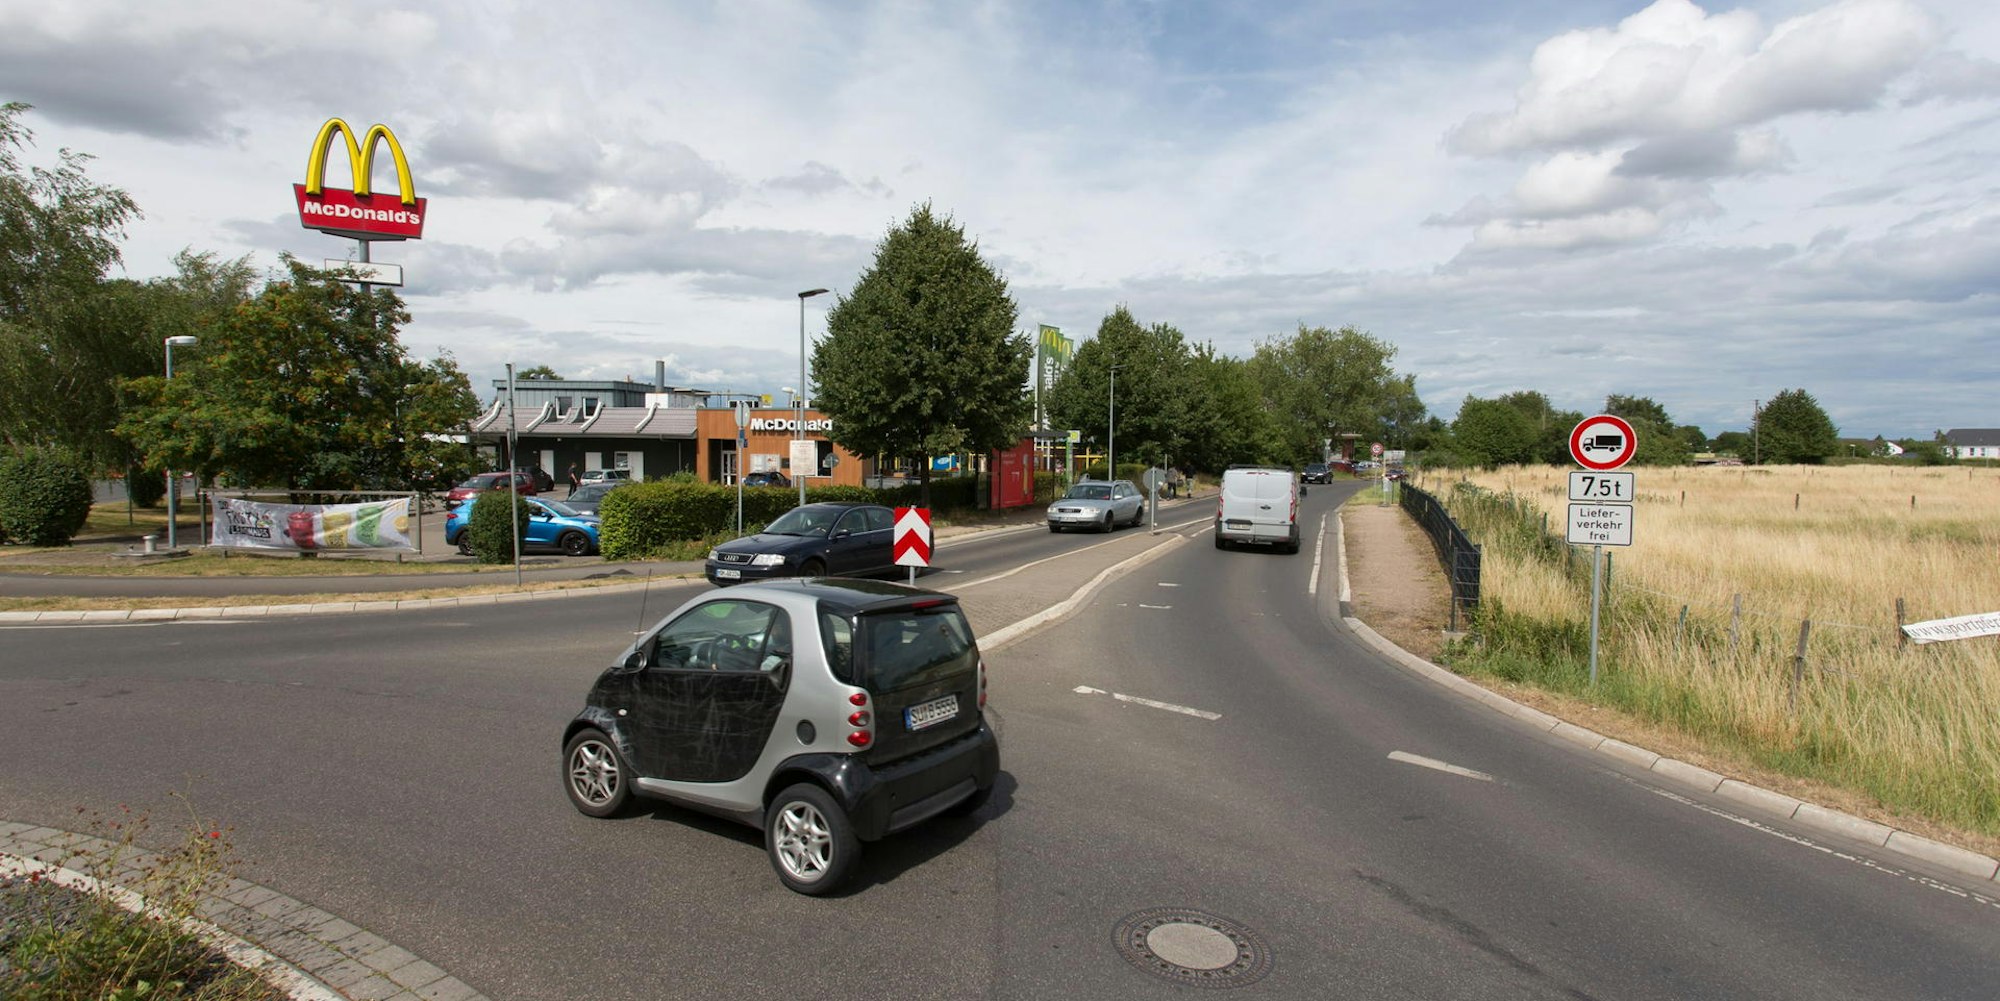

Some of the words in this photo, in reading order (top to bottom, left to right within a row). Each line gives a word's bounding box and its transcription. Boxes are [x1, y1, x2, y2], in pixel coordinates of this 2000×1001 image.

[303, 201, 420, 225] McDonald's
[1580, 508, 1620, 518] Liefer-
[1577, 520, 1622, 530] verkehr
[1590, 531, 1610, 540] frei
